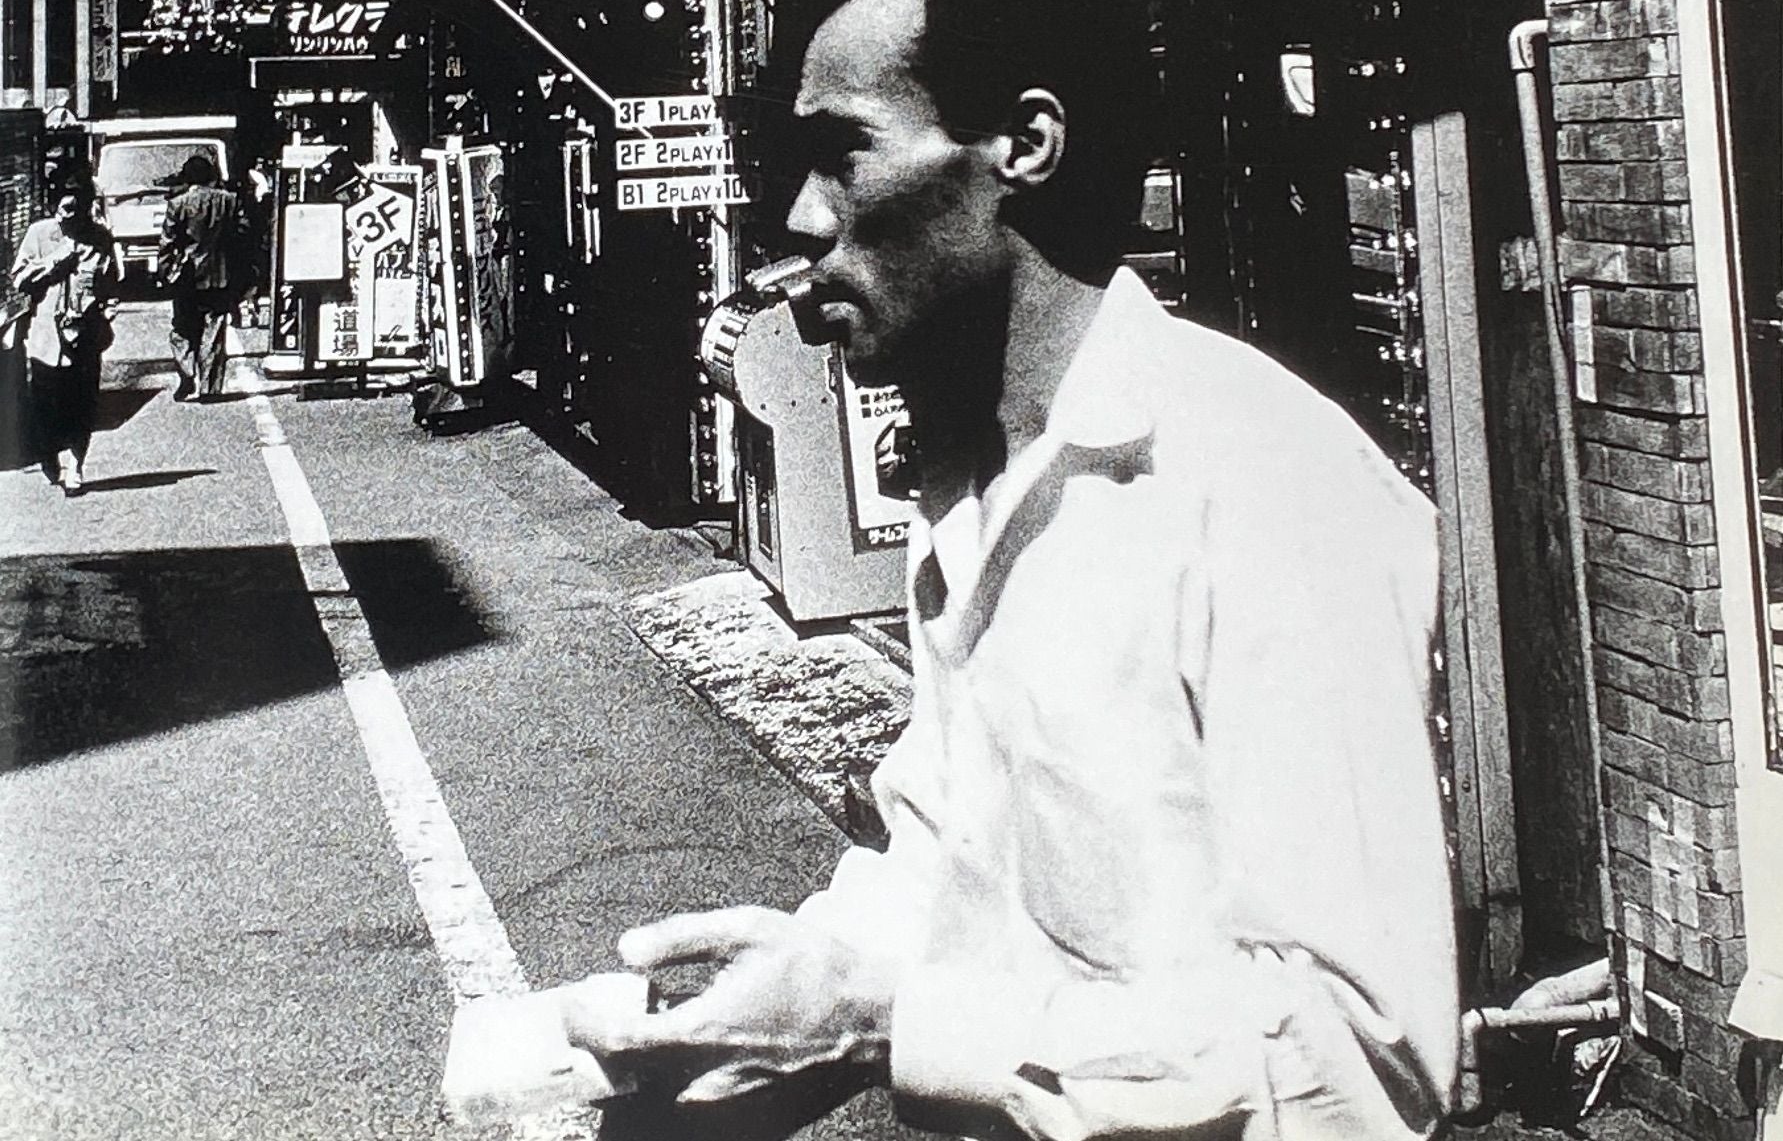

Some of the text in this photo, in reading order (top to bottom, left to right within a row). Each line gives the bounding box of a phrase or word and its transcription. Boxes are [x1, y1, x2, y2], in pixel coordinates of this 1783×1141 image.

[286, 1, 390, 34] テレクラ
[619, 100, 646, 124] 3F
[620, 143, 646, 165] 2F
[356, 195, 402, 243] 3F
